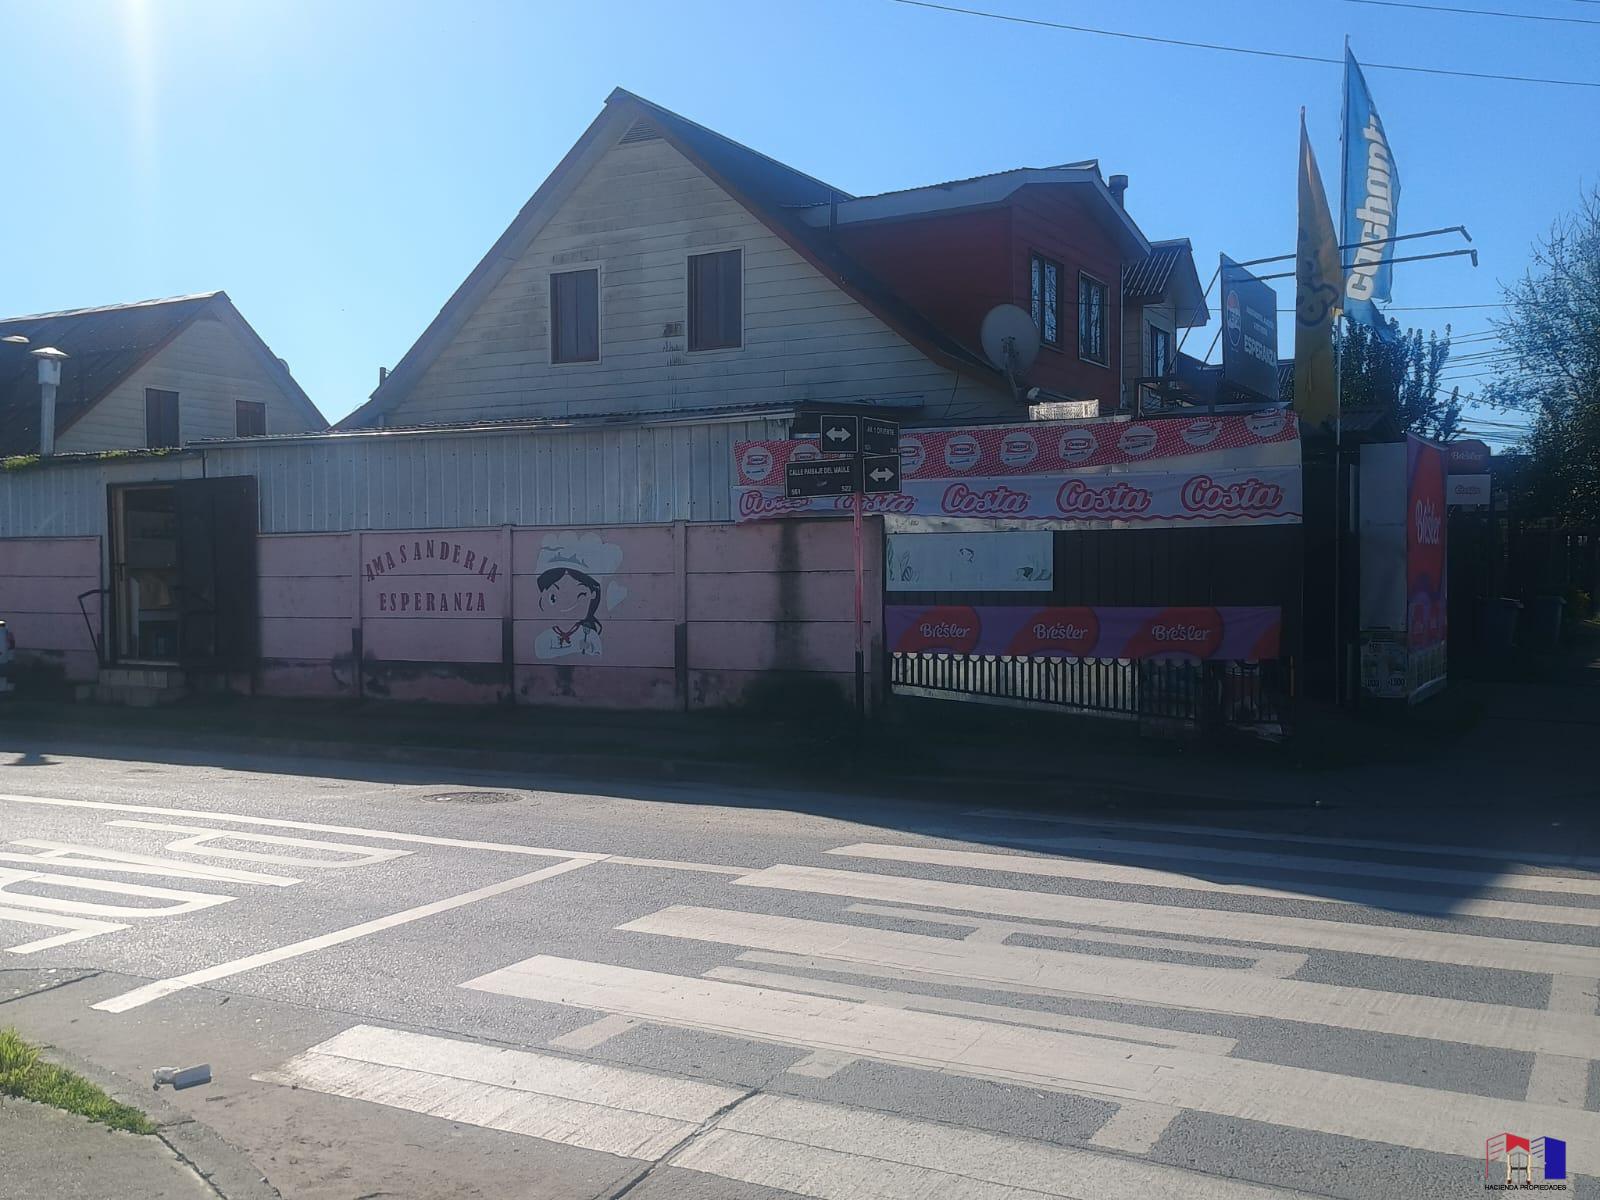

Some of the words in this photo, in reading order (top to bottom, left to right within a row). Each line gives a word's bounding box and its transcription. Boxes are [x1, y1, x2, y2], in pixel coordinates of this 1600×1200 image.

[789, 468, 804, 476] CALLE
[804, 467, 824, 475] PAISAJE
[824, 466, 833, 474] DEL
[834, 465, 850, 473] MAULE
[942, 482, 1028, 513] Costa
[1056, 479, 1150, 513] Costa
[1180, 475, 1282, 511] Costa
[366, 539, 498, 583] AMASANDERIA
[380, 592, 485, 612] ESPERANZA
